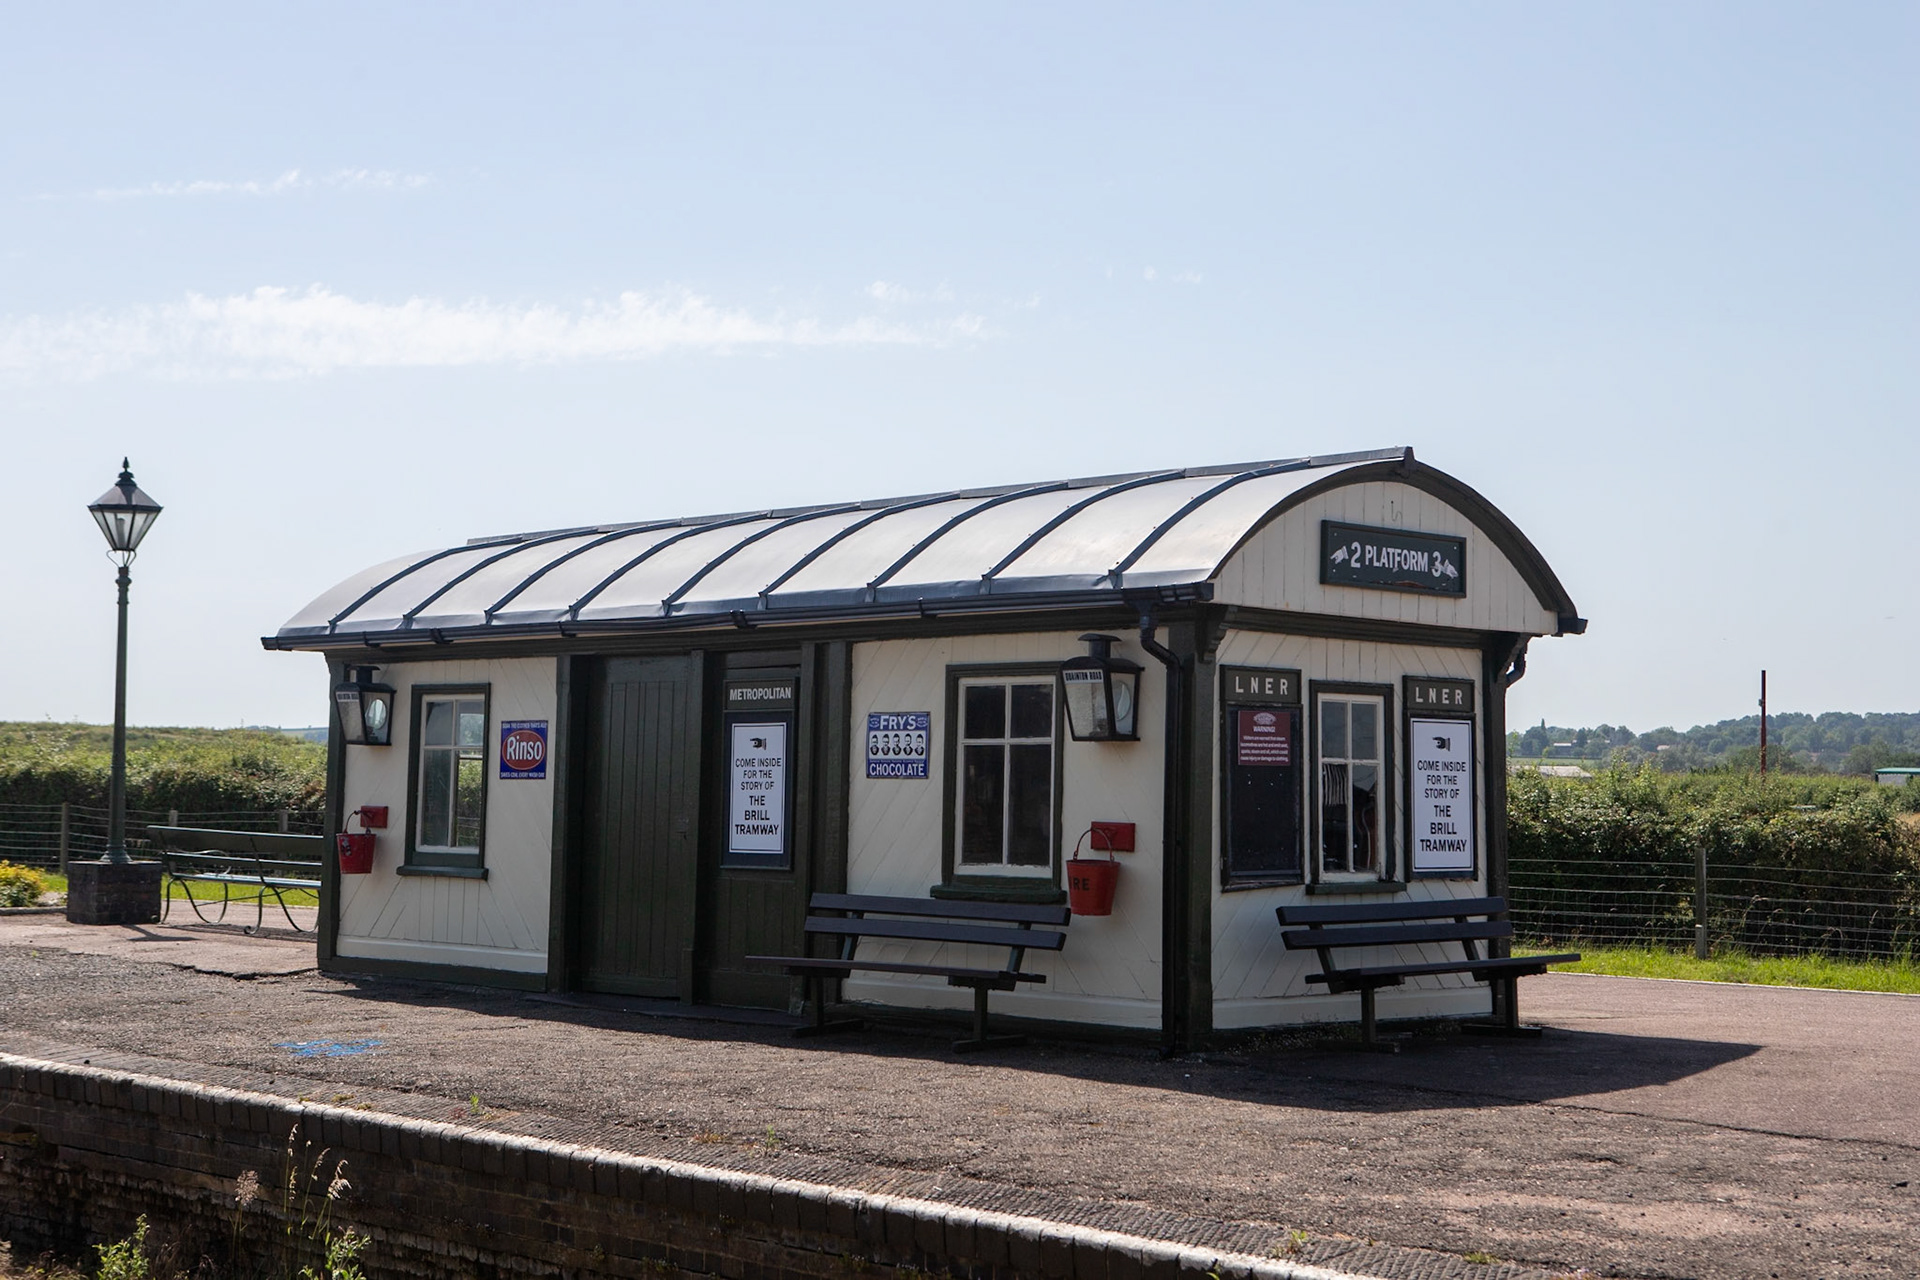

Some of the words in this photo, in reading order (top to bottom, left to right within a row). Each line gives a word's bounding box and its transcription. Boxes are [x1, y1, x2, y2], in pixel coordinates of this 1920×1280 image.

[1350, 541, 1361, 568] 2
[1365, 545, 1428, 572] PLATFORM
[1431, 551, 1442, 577] 3
[1235, 676, 1288, 695] LNER
[730, 687, 791, 700] METROPOLITAN
[1415, 687, 1462, 705] LNER
[880, 715, 916, 729] FRY'S
[507, 736, 542, 760] Rinso
[735, 758, 755, 767] COME
[758, 758, 781, 767] INSIDE
[1417, 760, 1440, 771] COME
[1442, 761, 1466, 772] INSIDE
[743, 770, 757, 779] FOR
[759, 770, 772, 778] THE
[870, 763, 924, 775] CHOCOLATE
[741, 782, 763, 790] STORY
[765, 781, 774, 790] OF
[1427, 775, 1441, 785] FOR
[1443, 775, 1457, 785] THE
[1424, 788, 1448, 799] STORY
[1450, 789, 1460, 798] OF
[749, 795, 765, 806] THE
[744, 810, 770, 820] BRILL
[1434, 805, 1451, 817] THE
[735, 824, 779, 835] TRAMWAY
[1430, 822, 1457, 834] BRILL
[1420, 839, 1467, 852] TRAMWAY
